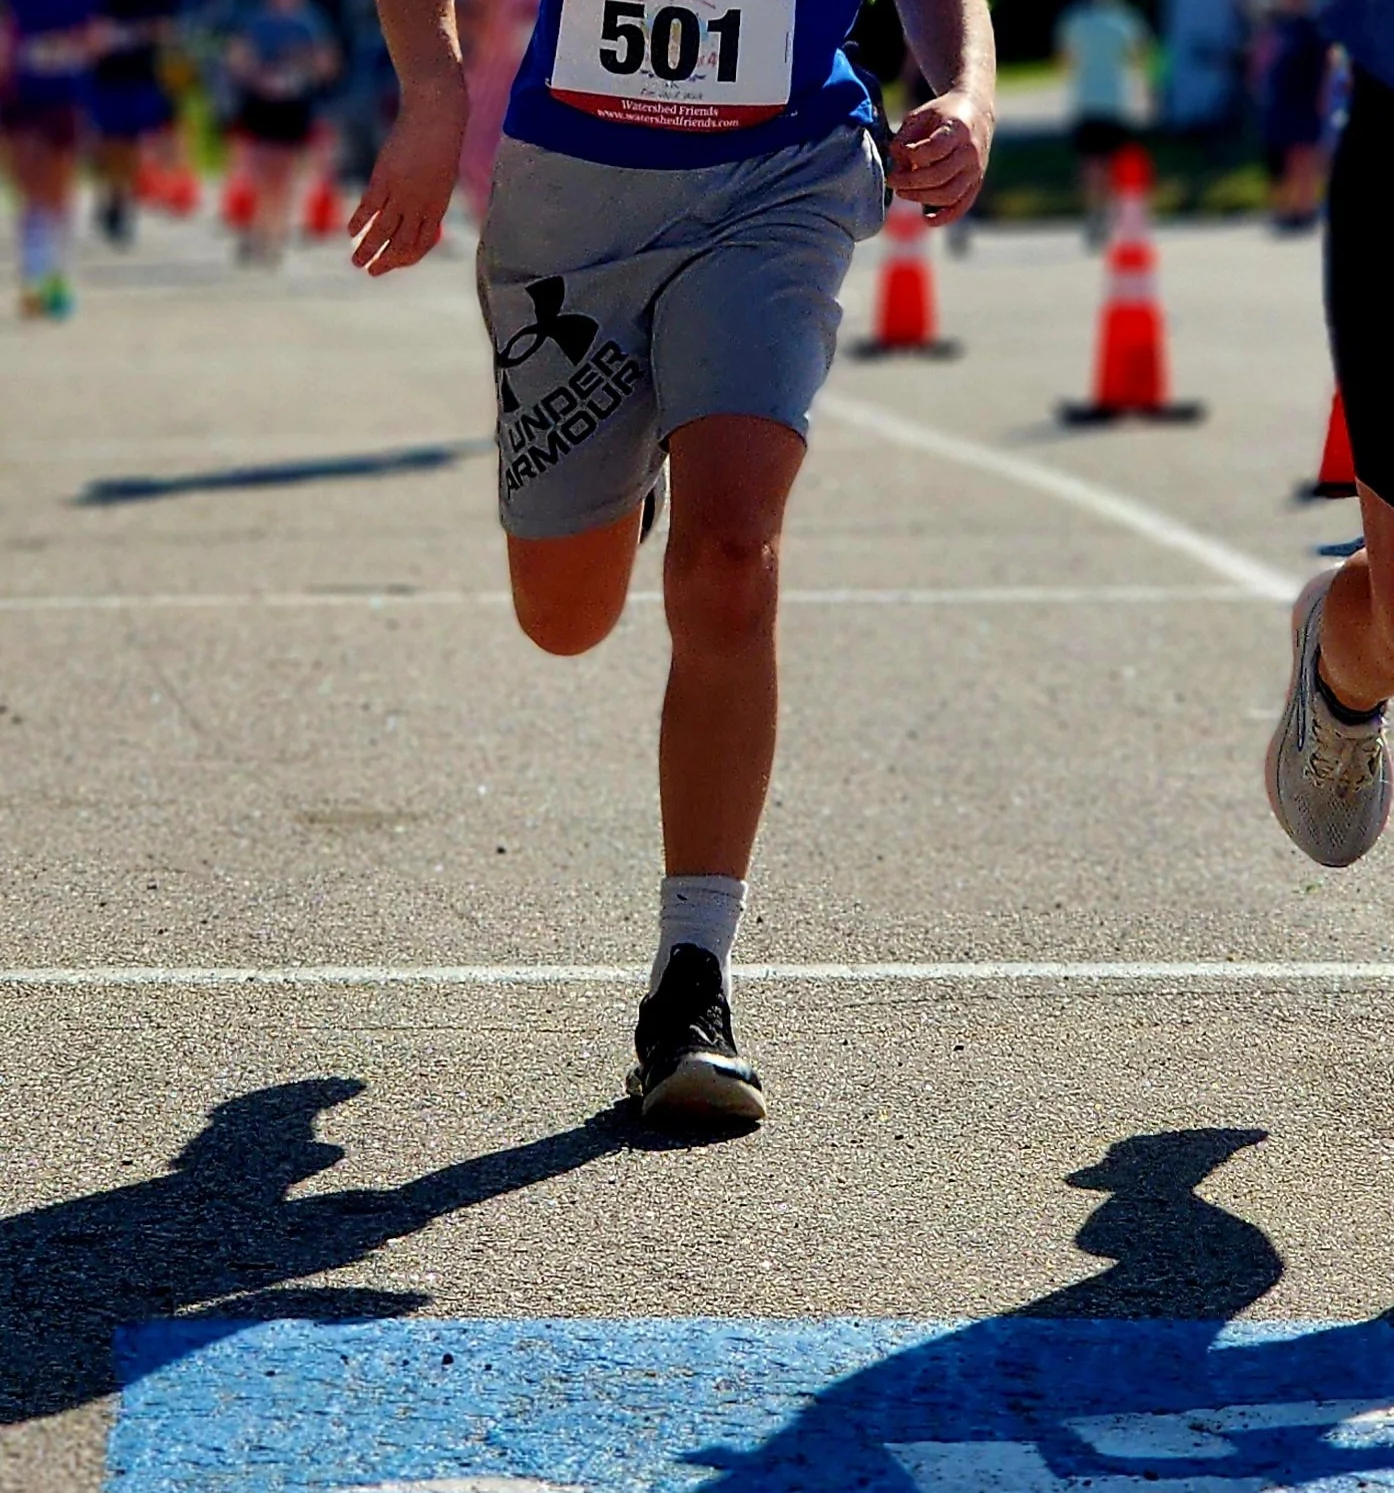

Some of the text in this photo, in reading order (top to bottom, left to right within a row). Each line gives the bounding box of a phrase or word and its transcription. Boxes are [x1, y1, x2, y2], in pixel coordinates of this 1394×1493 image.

[599, 0, 742, 83] 501
[597, 109, 739, 128] www.watershedfriends.com
[621, 99, 719, 116] Watershed Friends
[505, 360, 644, 499] ARMOUR
[508, 340, 629, 453] UNDER
